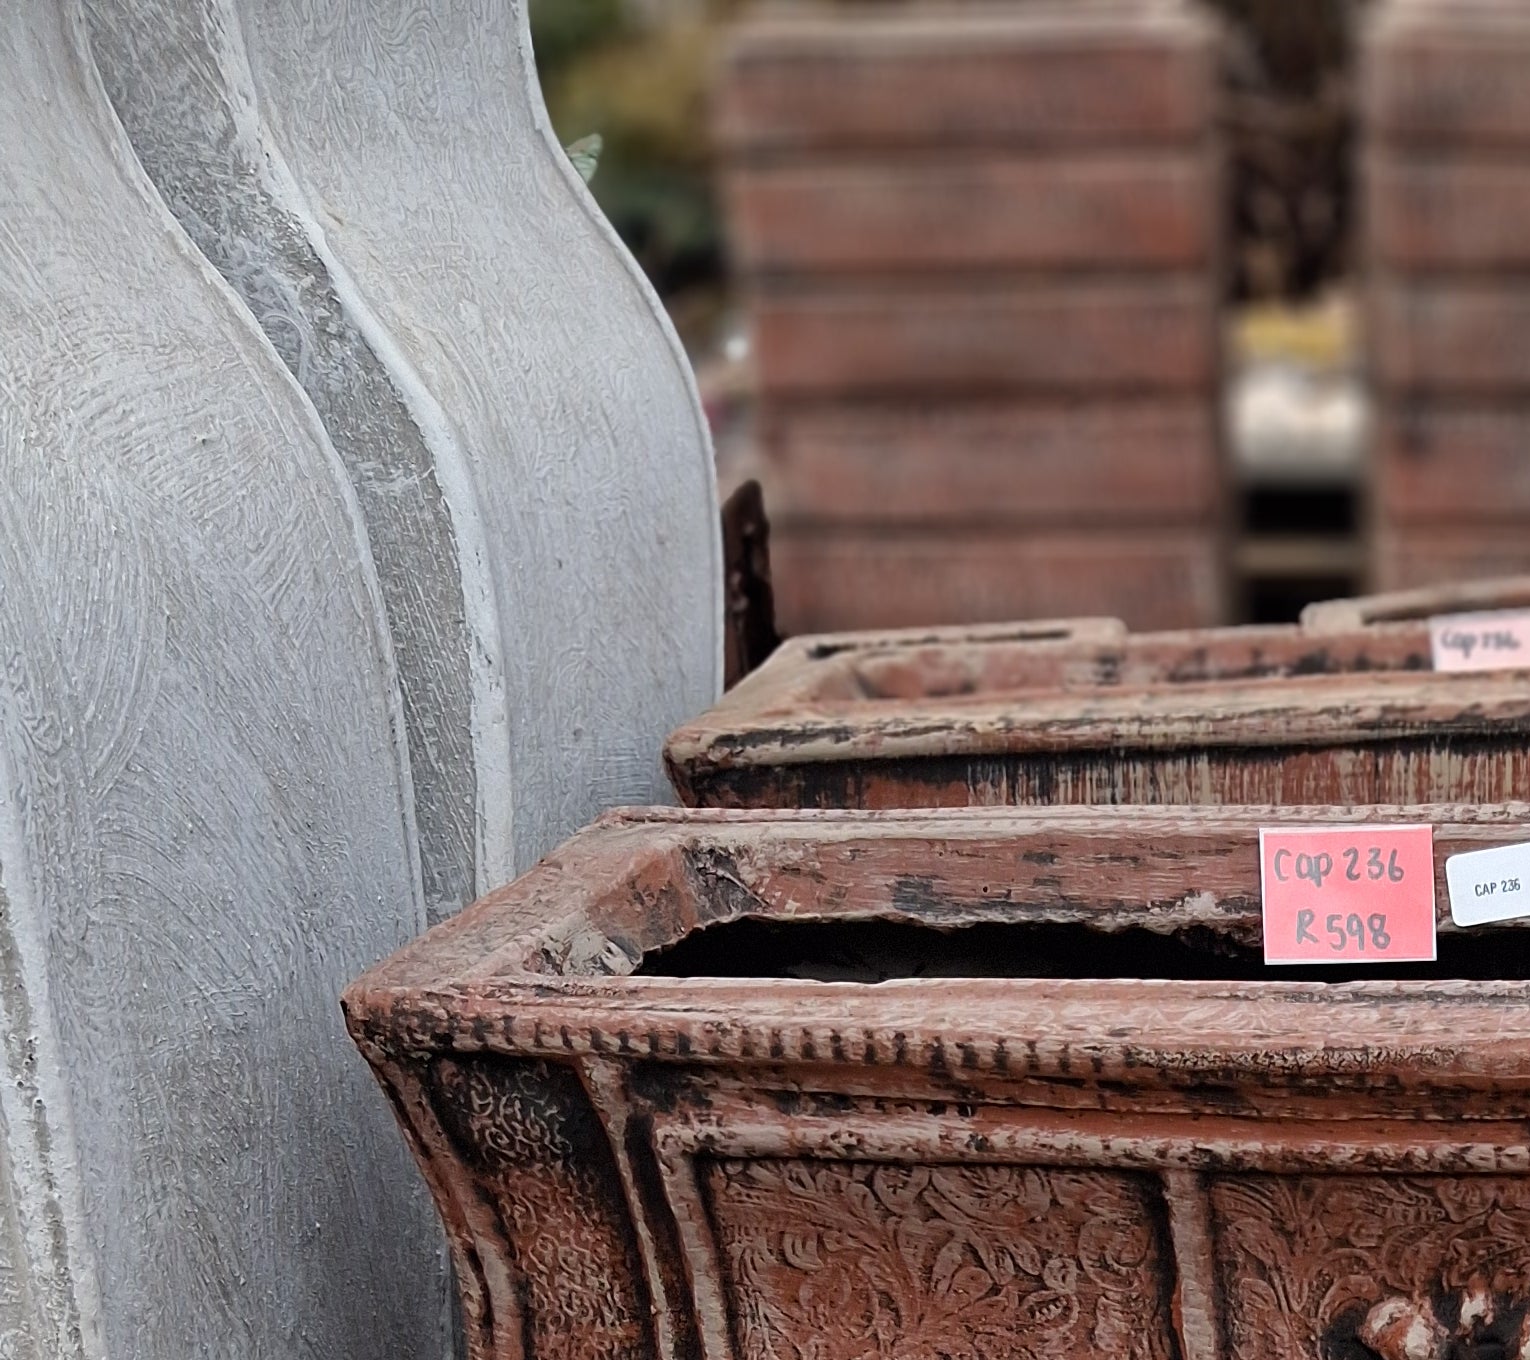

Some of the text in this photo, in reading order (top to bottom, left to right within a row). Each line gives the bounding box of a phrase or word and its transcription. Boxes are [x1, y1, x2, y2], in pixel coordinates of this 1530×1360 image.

[1343, 847, 1405, 882] 236
[1474, 878, 1521, 897] CAP 236
